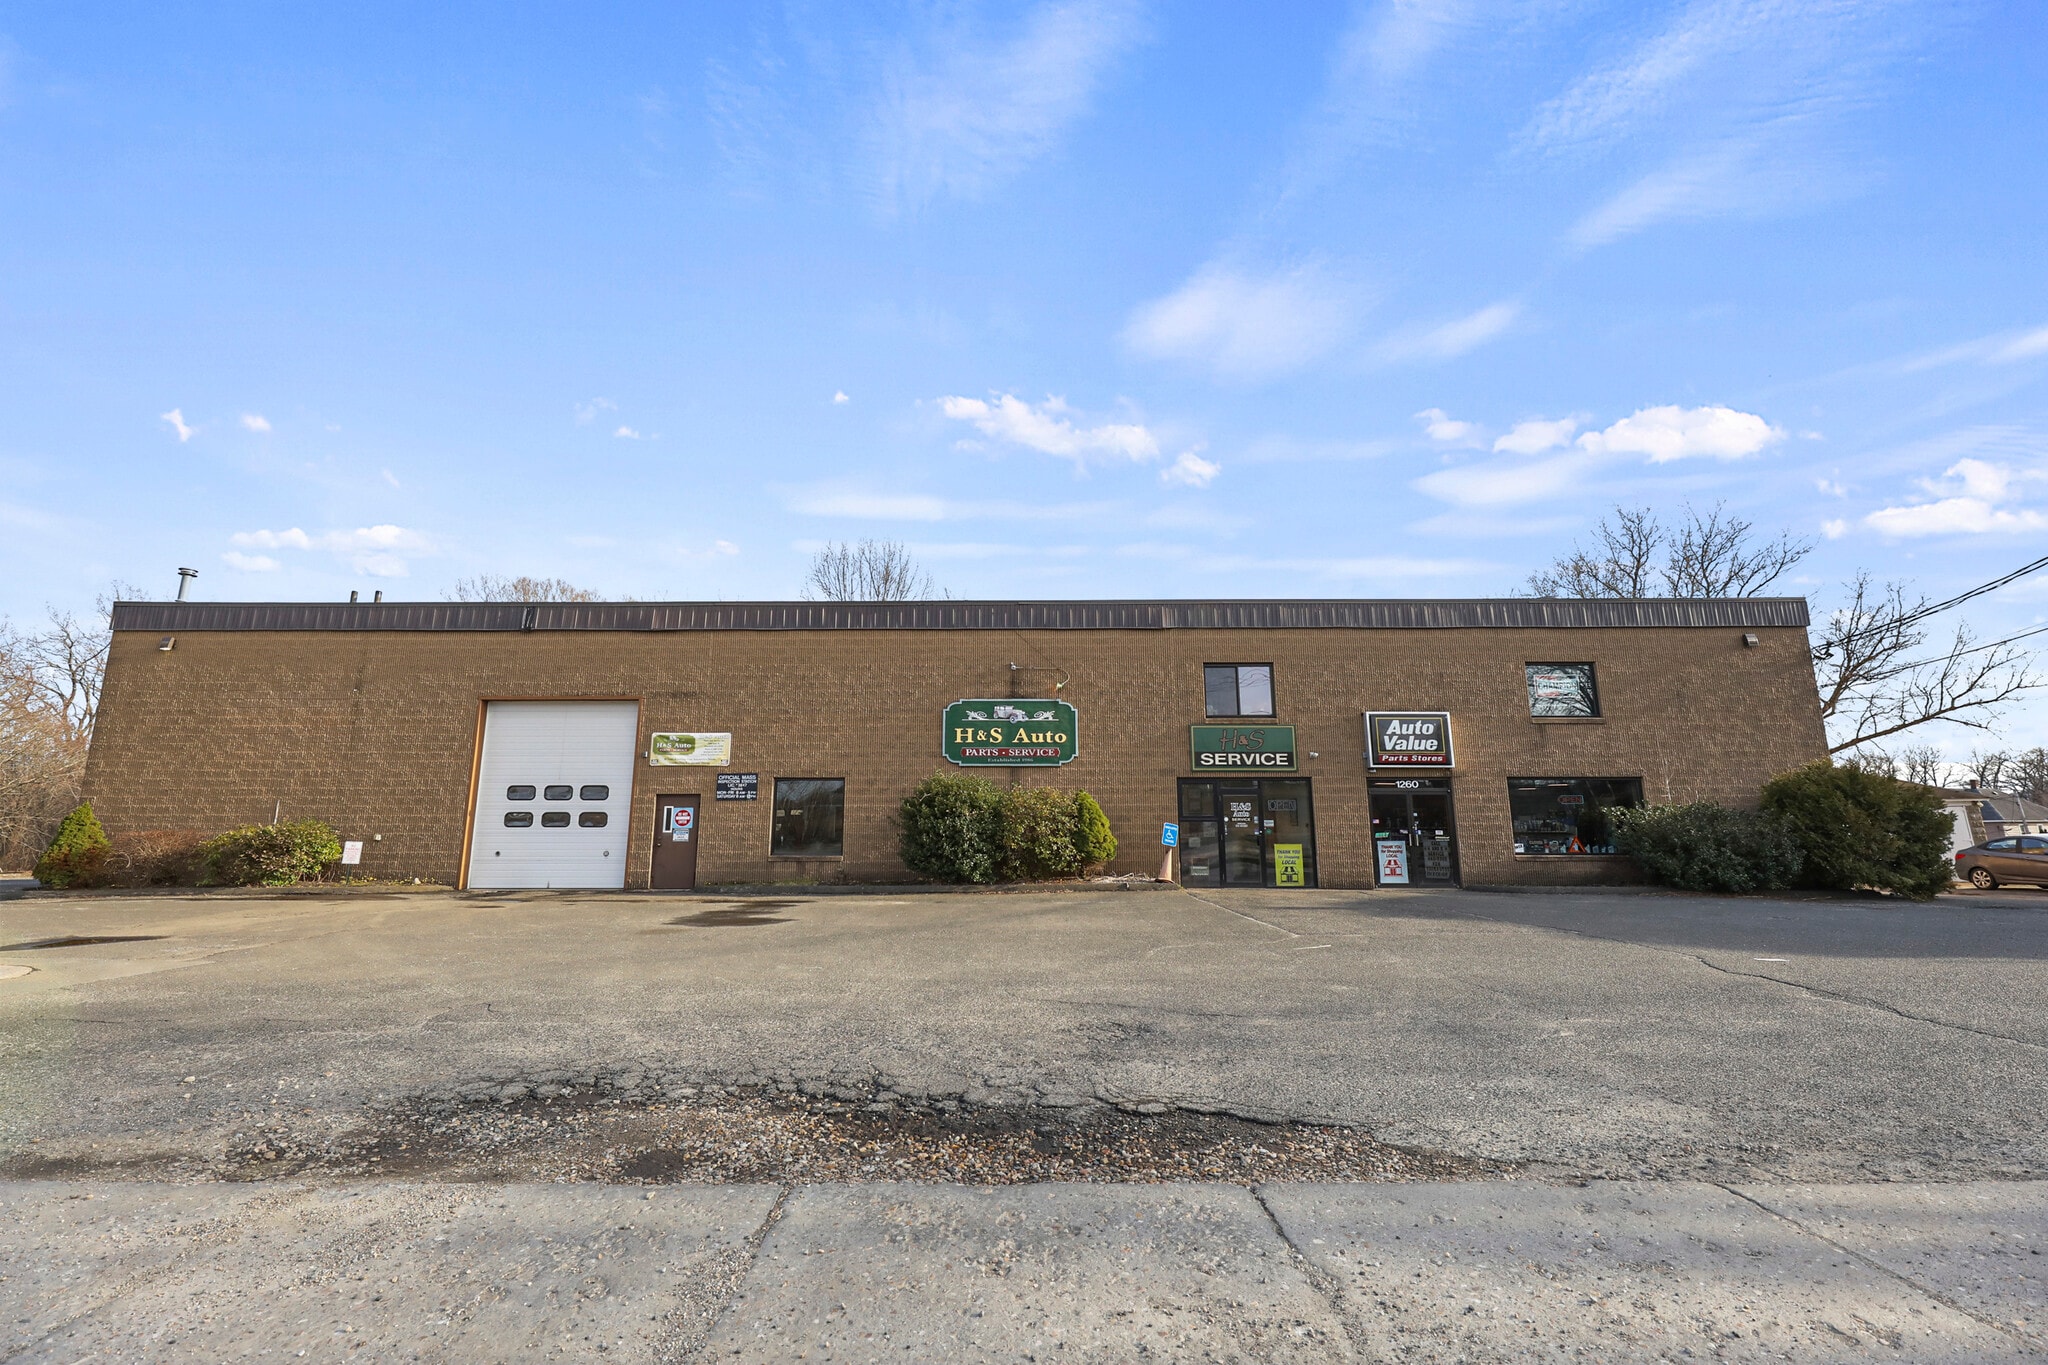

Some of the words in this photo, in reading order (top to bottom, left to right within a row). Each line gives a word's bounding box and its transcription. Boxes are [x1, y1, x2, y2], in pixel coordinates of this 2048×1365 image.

[1386, 719, 1434, 735] Auto
[954, 727, 1003, 743] H&S
[1012, 727, 1067, 743] Auto
[1220, 729, 1265, 750] H&S
[1383, 735, 1438, 751] Value
[965, 748, 999, 757] PARTS
[1008, 748, 1056, 757] SERVICE
[1200, 753, 1289, 766] SERVICE
[1382, 754, 1408, 763] Parts
[1411, 754, 1443, 762] Stores
[1395, 780, 1419, 789] 1260
